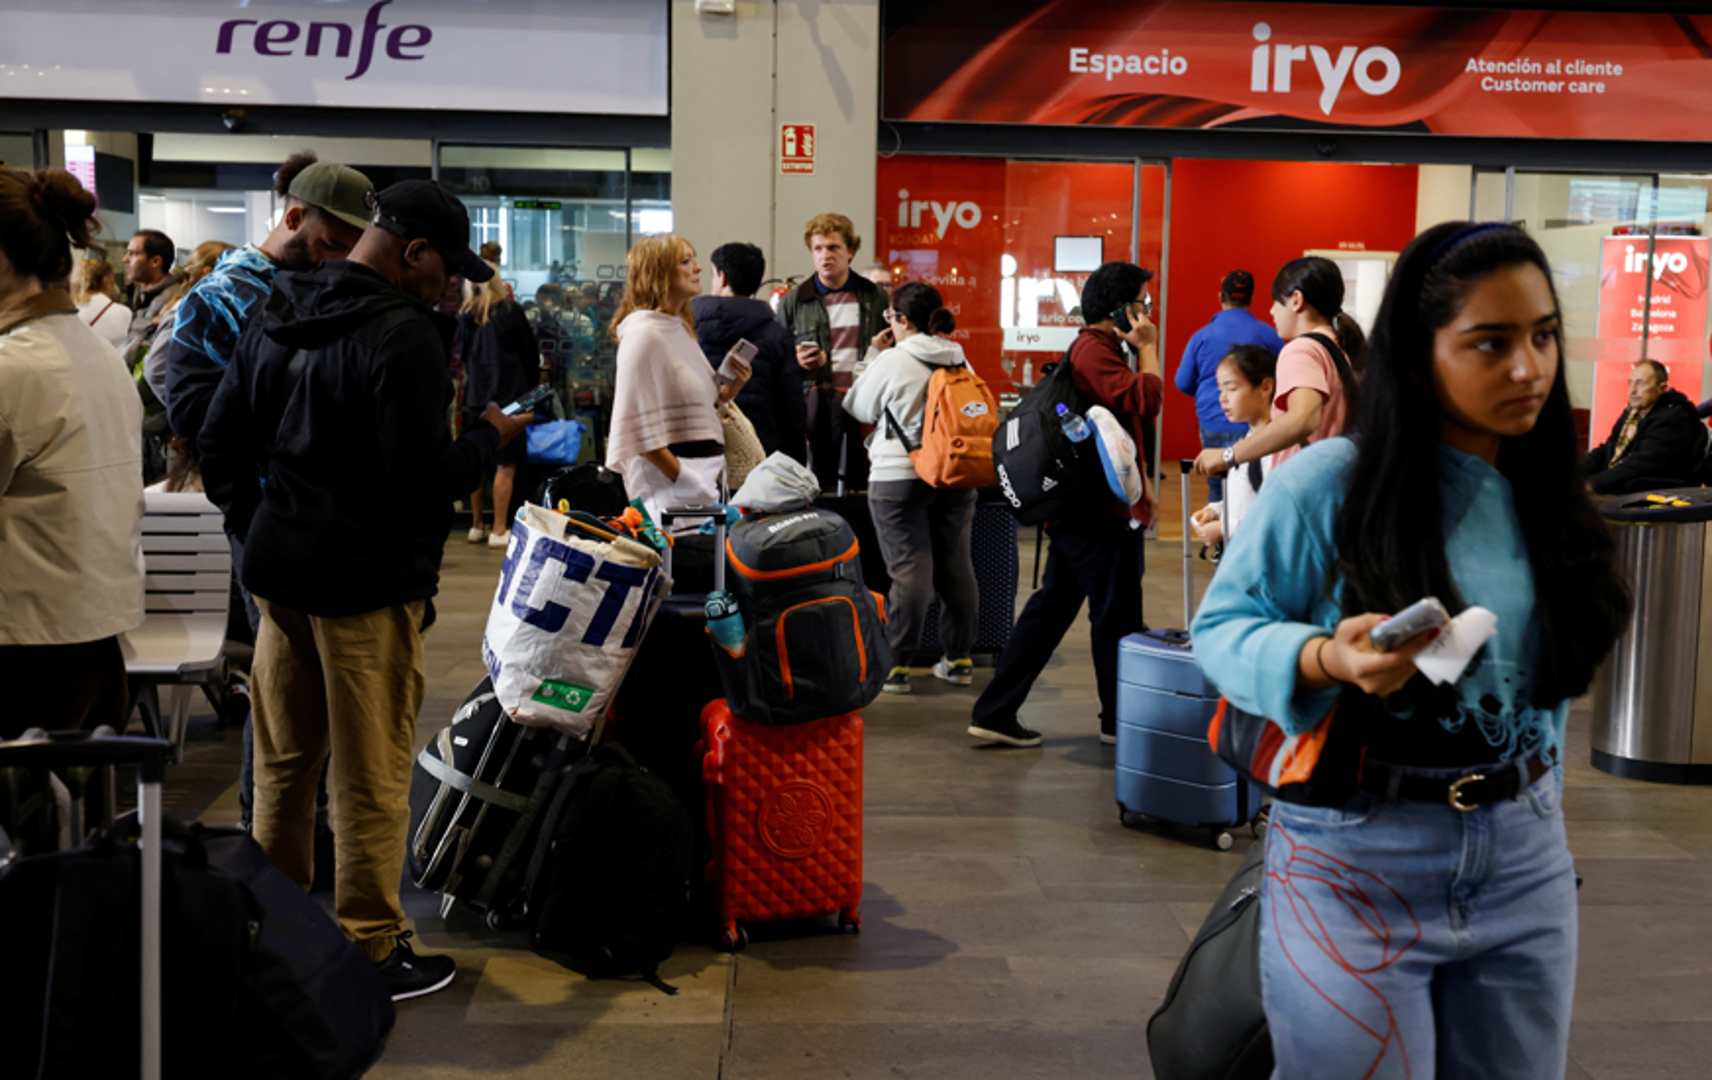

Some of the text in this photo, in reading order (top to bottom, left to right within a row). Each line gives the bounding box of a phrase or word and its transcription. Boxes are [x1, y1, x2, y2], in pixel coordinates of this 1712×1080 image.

[216, 0, 433, 81] renfe
[1069, 22, 1401, 115] Espacio iryo
[1465, 57, 1623, 76] Atención al cliente
[1481, 76, 1606, 94] Customer care
[898, 188, 982, 240] iryo
[1624, 244, 1688, 281] iryo
